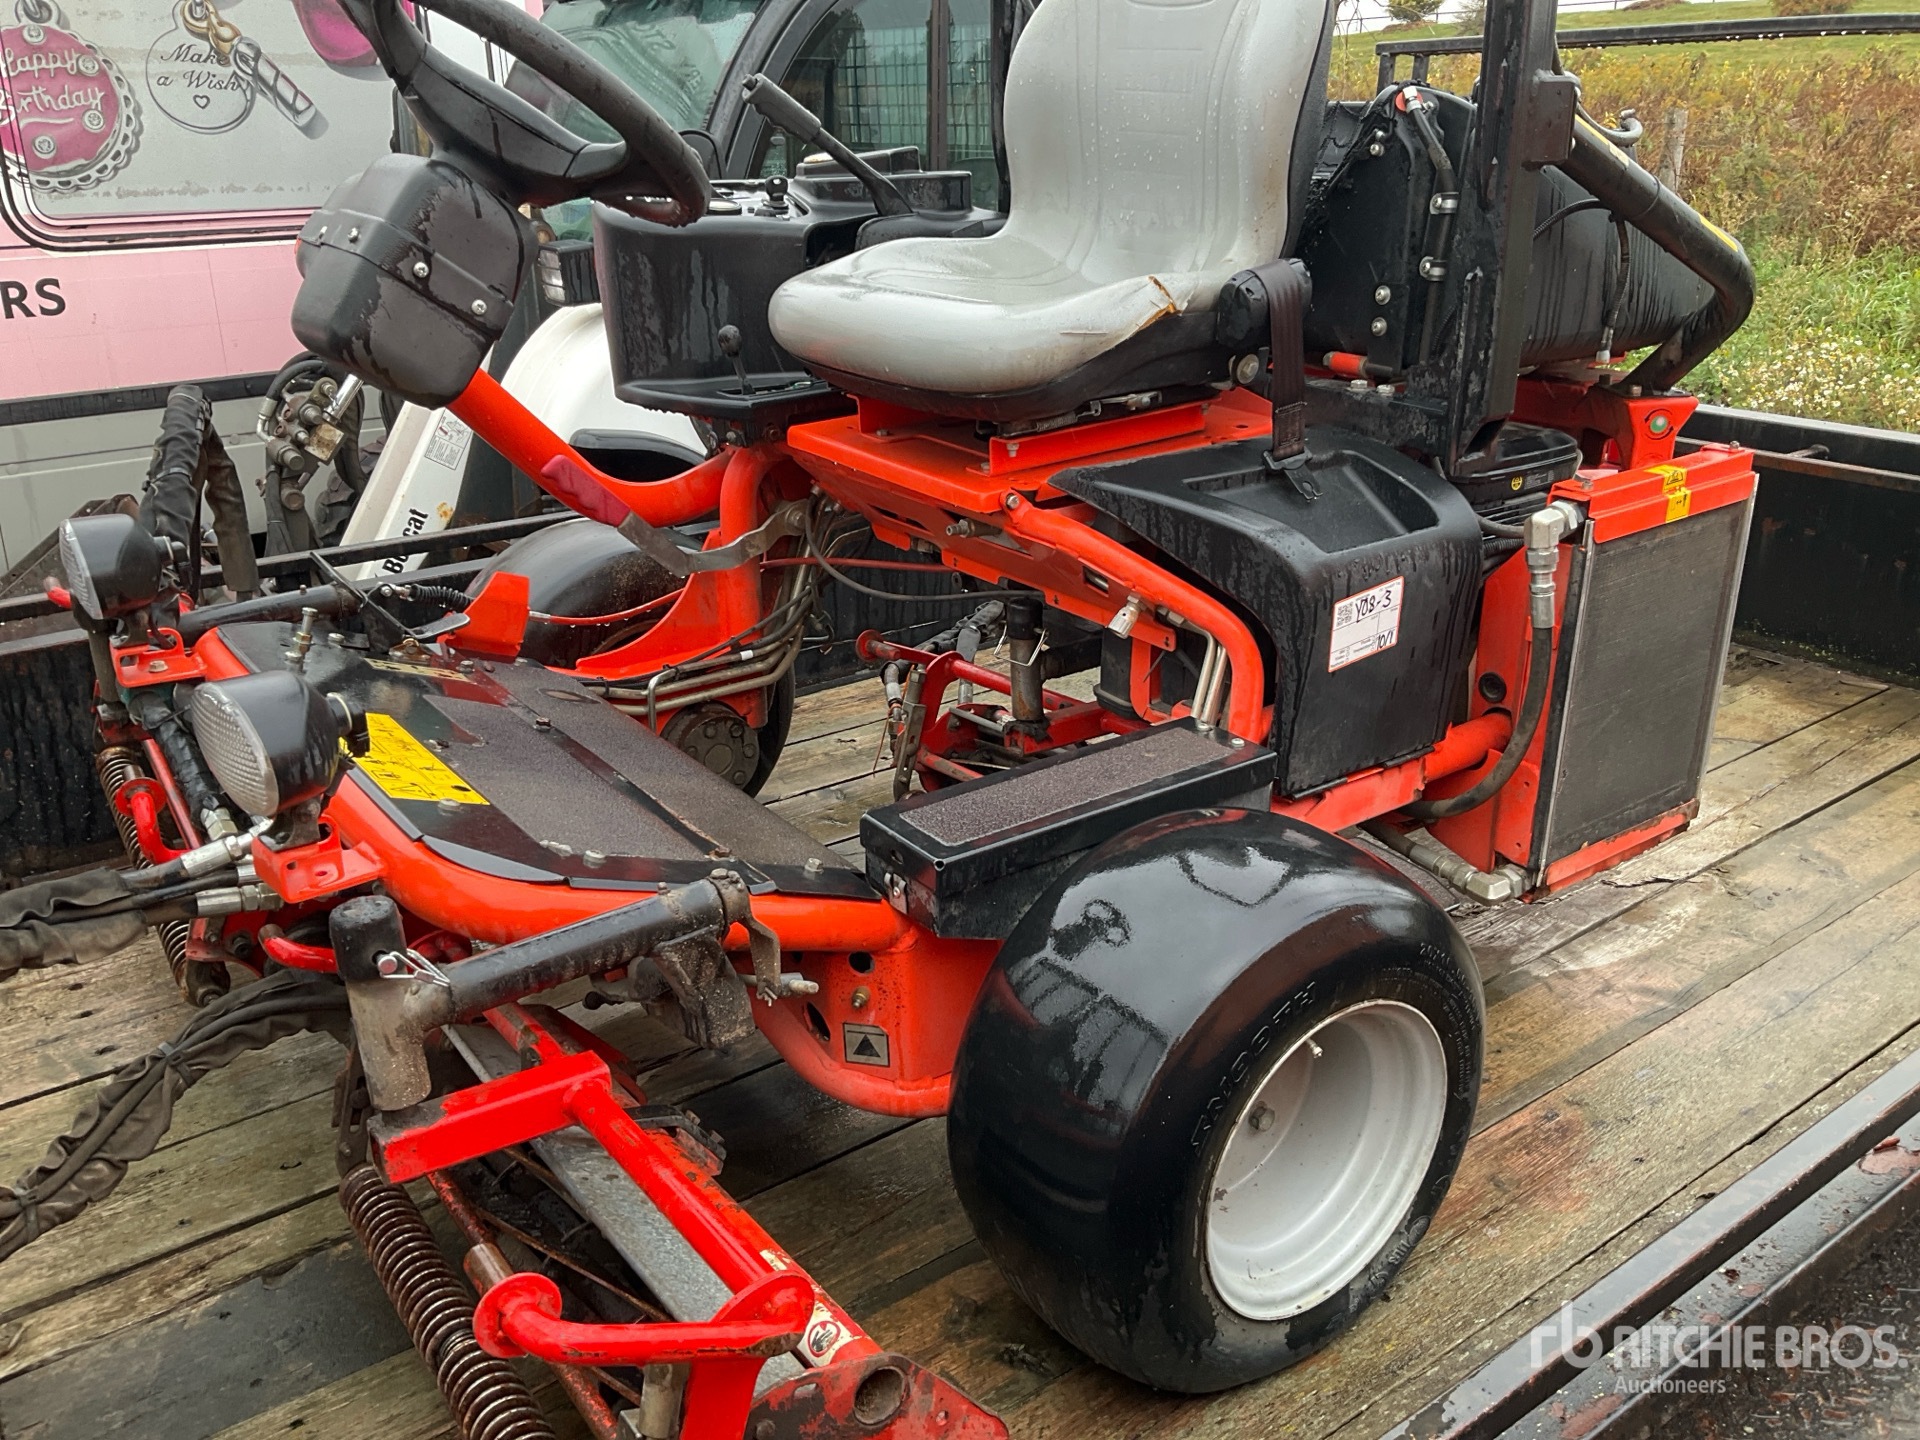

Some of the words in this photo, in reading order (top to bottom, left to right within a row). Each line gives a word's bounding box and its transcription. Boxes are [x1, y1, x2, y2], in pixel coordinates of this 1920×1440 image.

[160, 43, 230, 66] Make
[156, 75, 174, 87] a
[182, 69, 243, 92] Wish
